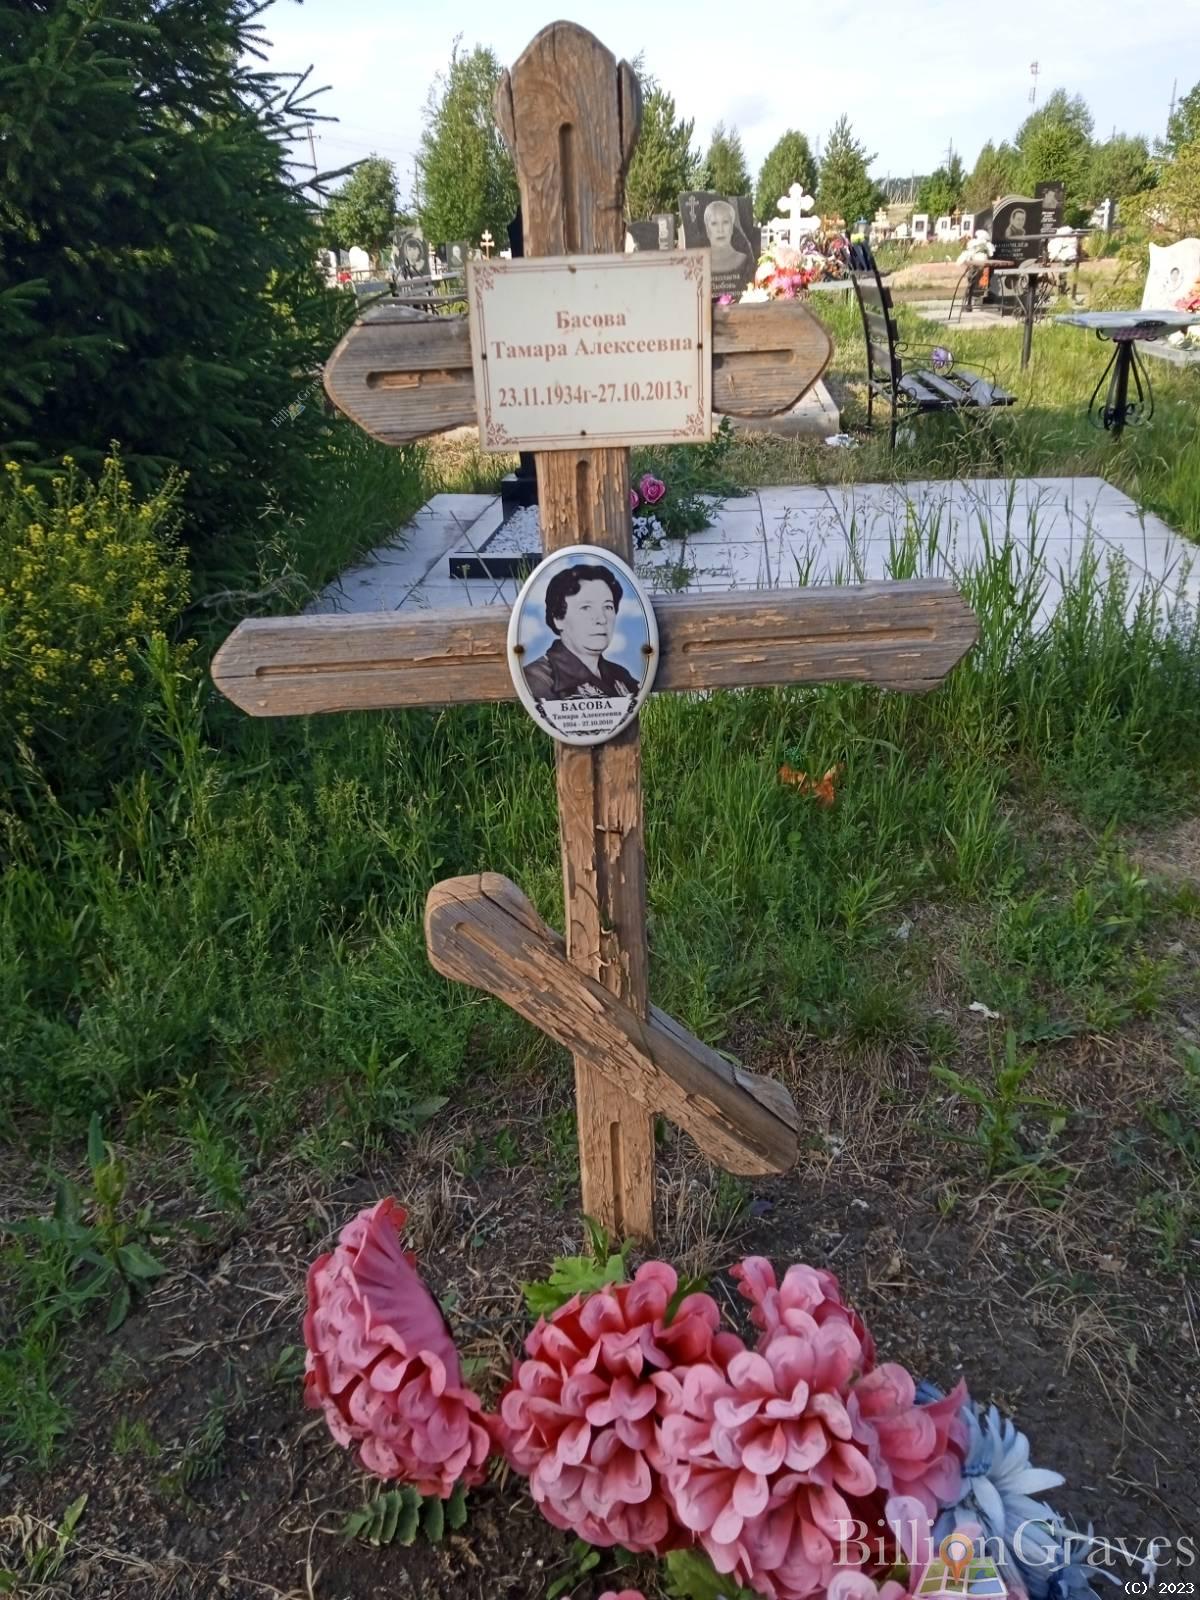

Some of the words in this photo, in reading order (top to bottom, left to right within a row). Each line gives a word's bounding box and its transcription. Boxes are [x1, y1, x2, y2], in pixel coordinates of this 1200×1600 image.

[555, 310, 627, 330] Басова
[490, 341, 568, 362] Тамара
[574, 336, 693, 356] Алексеевна
[498, 380, 692, 408] 23.11.1934г-27.10.2013г
[561, 700, 613, 712] БАСОВА
[552, 713, 579, 721] Тамара
